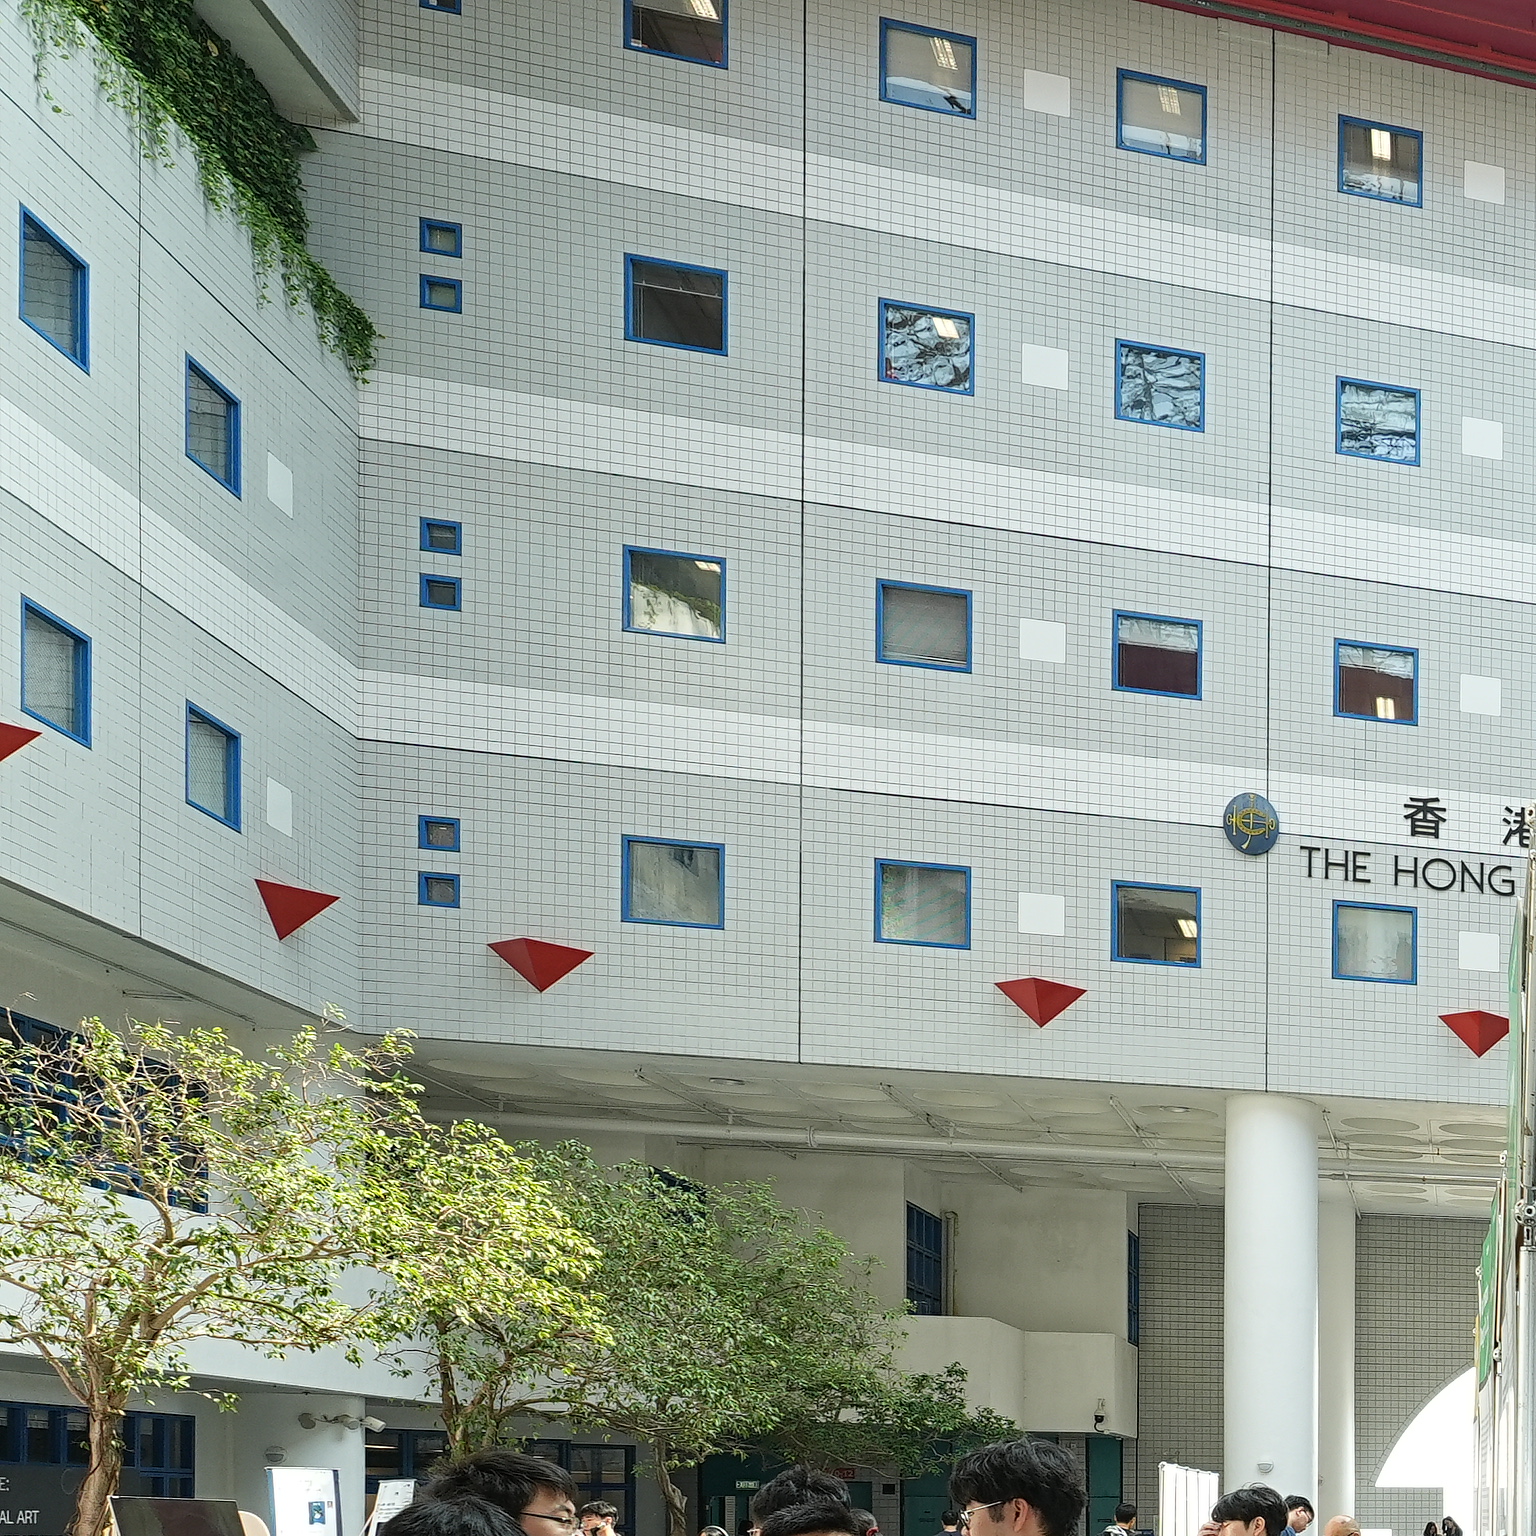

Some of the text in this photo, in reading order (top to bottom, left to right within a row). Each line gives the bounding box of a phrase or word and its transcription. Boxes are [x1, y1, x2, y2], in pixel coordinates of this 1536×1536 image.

[1300, 845, 1372, 884] THE
[1394, 857, 1517, 897] HONG
[16, 1510, 40, 1524] ART
